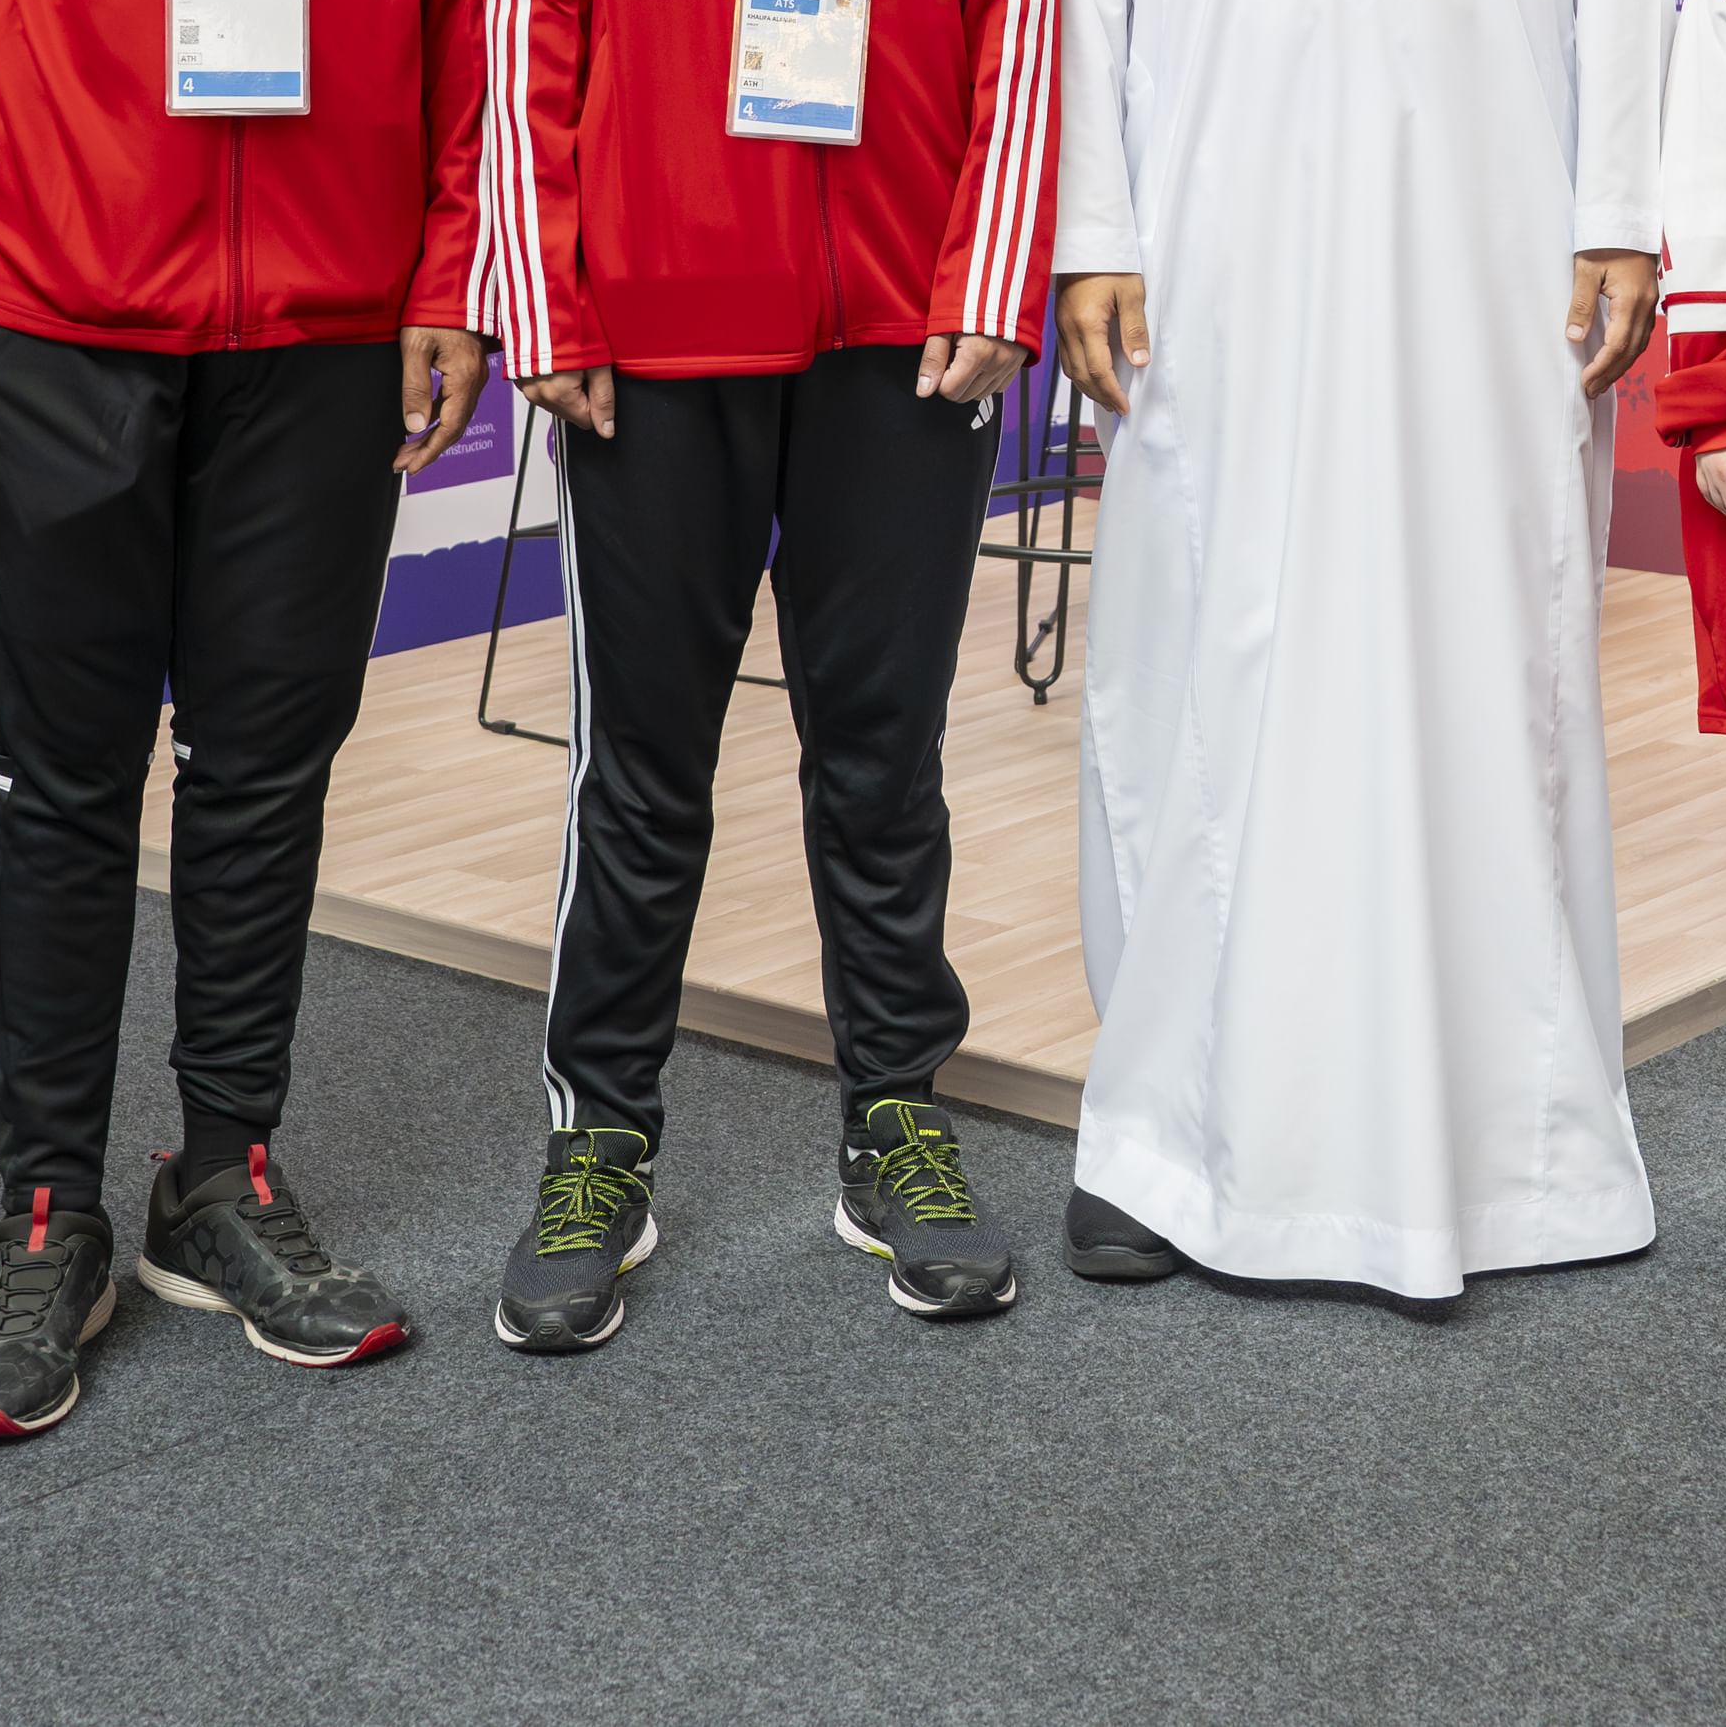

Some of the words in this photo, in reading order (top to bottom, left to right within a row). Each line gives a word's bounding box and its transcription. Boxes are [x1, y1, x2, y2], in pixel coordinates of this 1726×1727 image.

[181, 55, 197, 63] ATH
[183, 78, 194, 92] 4
[743, 79, 758, 88] ATH
[743, 102, 753, 116] 4
